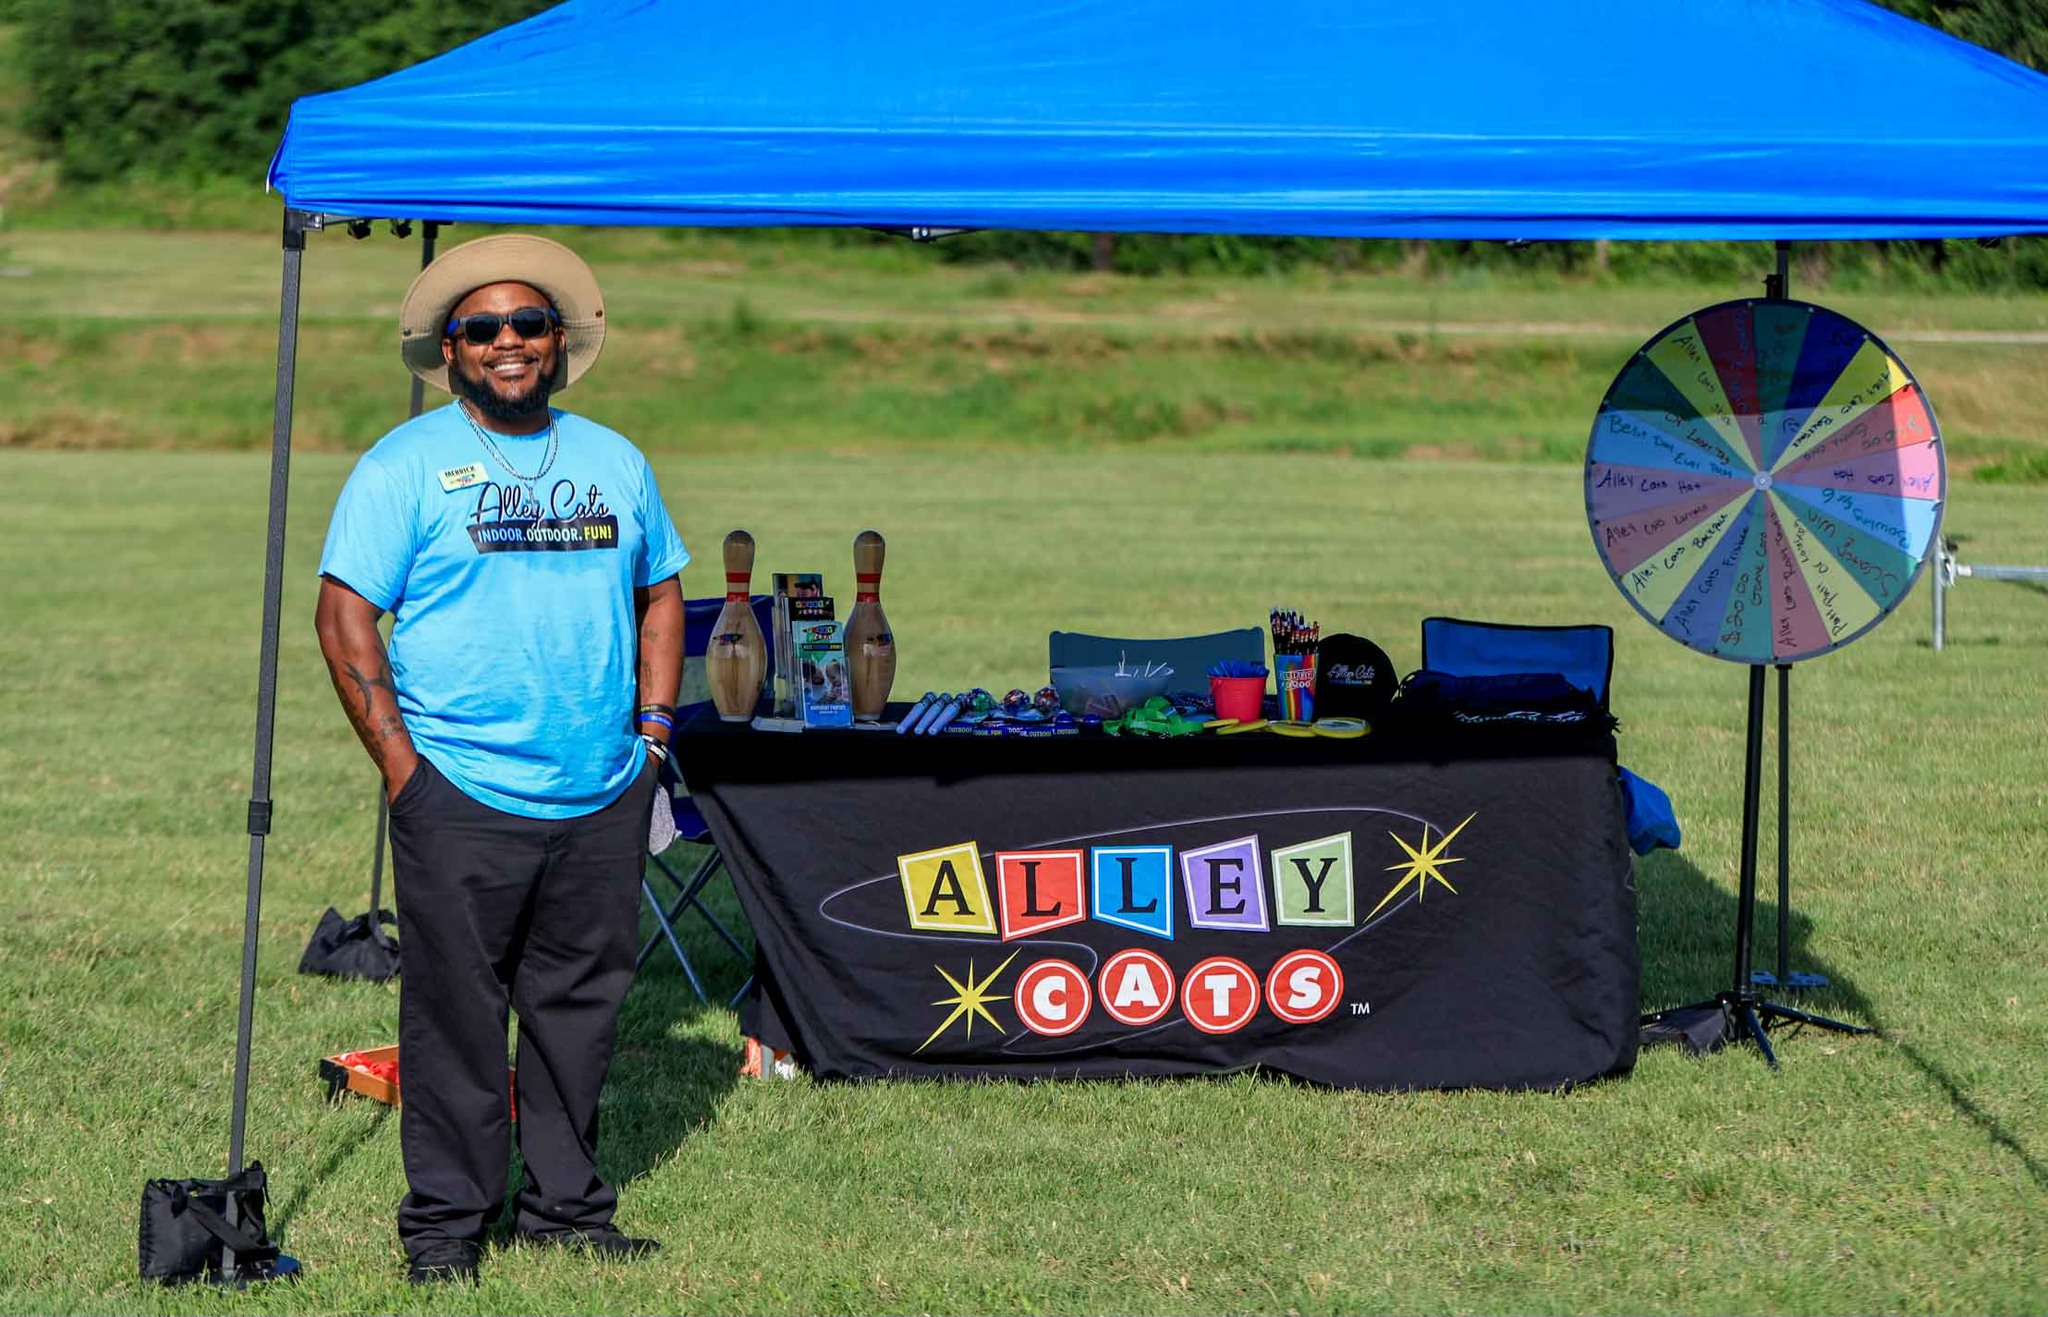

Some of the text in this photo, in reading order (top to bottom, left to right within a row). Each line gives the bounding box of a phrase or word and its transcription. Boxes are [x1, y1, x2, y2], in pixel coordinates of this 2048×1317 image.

[1597, 468, 1634, 488] Alley
[470, 479, 611, 528] Alley Cats
[584, 525, 612, 540] FUN!
[920, 857, 1338, 918] ALLEY
[1033, 963, 1325, 1020] CATS
